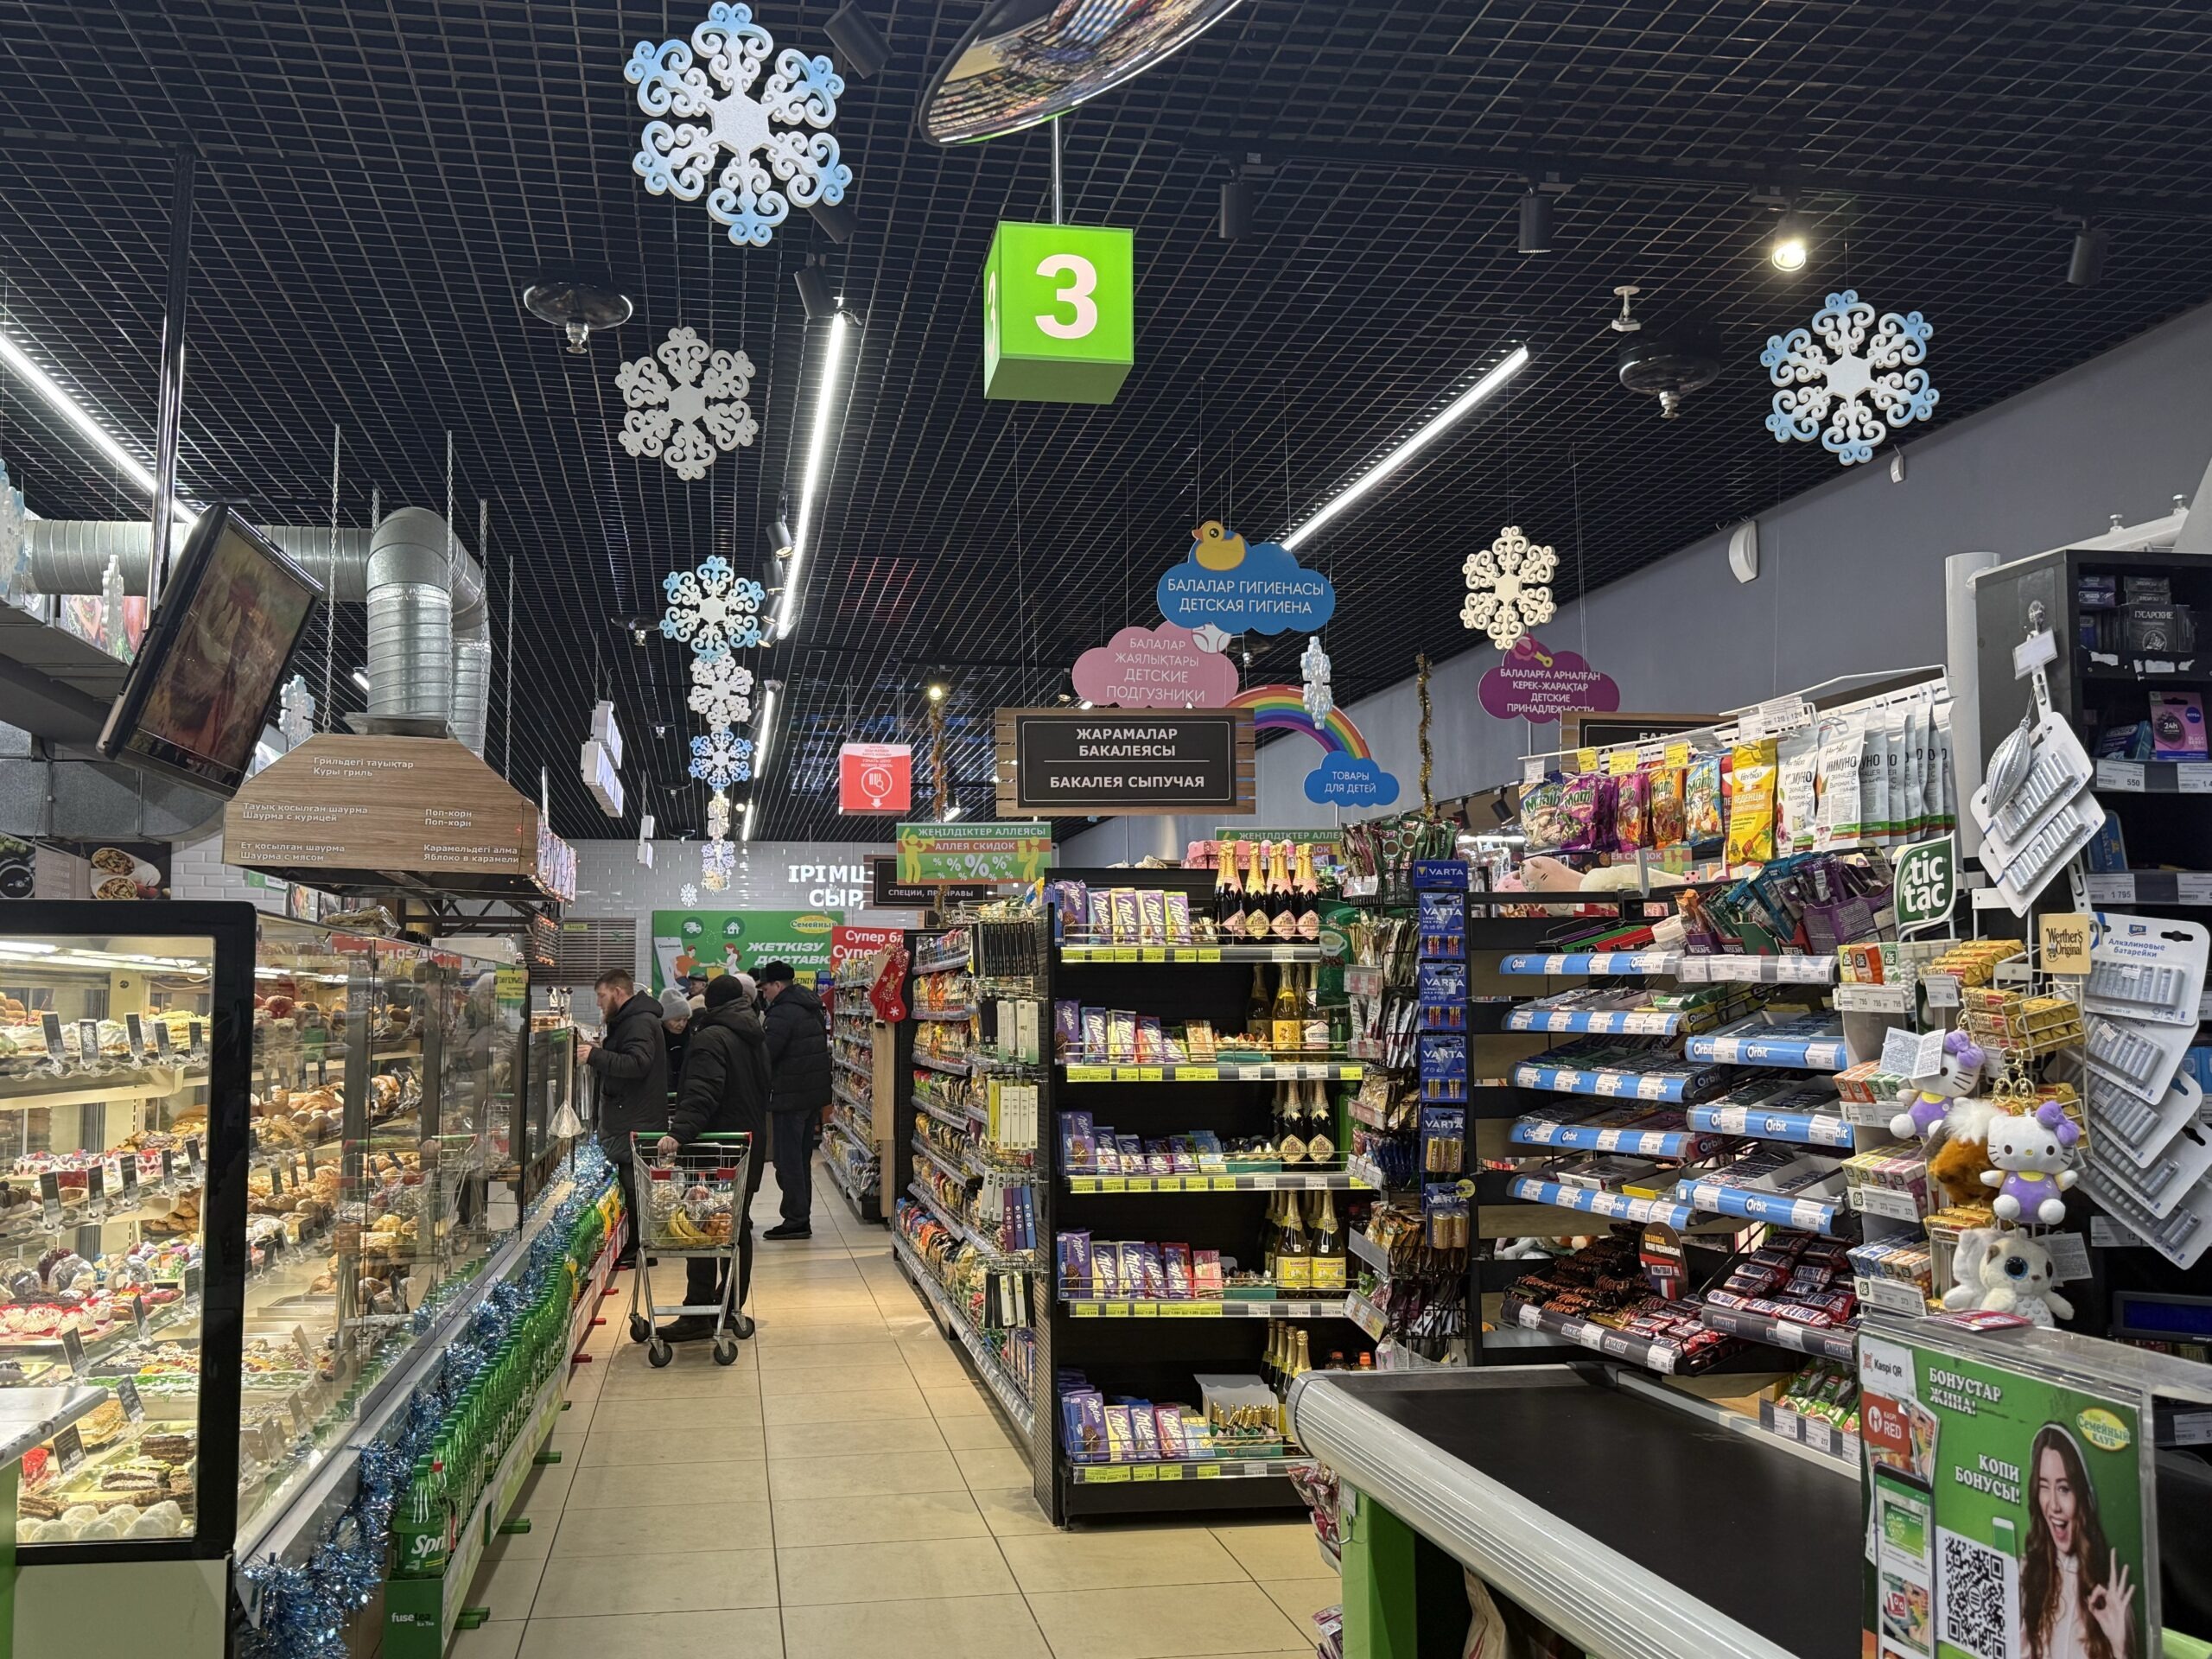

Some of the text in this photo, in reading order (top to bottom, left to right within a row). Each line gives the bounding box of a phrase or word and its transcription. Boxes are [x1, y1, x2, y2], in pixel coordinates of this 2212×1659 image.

[1035, 253, 1097, 339] 3
[1167, 578, 1324, 595] БАЛАЛАР ГИГИЕНАСЫ
[1179, 598, 1312, 614] ДЕТСКАЯ ГИГИЕНА
[2135, 610, 2174, 620] ГУСАРСКИЕ
[1129, 638, 1185, 651] БАЛАЛАР
[1115, 652, 1198, 667] ЖАЯЛЫҚТАРЫ
[1124, 668, 1188, 683] ДЕТСКИЕ
[1500, 669, 1600, 681] БАЛАЛАРҒА АРНАЛҒАН
[1106, 685, 1205, 702] ПОДГУЗНИКИ
[1512, 681, 1588, 693] КЕРЕК-ЖАРАҚТАР
[1530, 692, 1570, 702] ДЕТСКИЕ
[1076, 728, 1178, 740] ЖАРАМАЛАР
[1079, 745, 1175, 757] БАКАЛЕЯСЫ
[314, 757, 414, 769] Грильдегі тауықтар
[1826, 756, 1857, 772] ИММУНО
[314, 767, 340, 777] Куры
[1332, 771, 1369, 781] ТОВАРЫ
[1050, 776, 1205, 788] БАКАЛЕЯ СЫПУЧАЯ
[1325, 784, 1376, 794] ДЛЯ ДЕТЕЙ
[2127, 779, 2140, 787] 550
[244, 802, 276, 812] Тауық
[327, 806, 368, 816] шаурма
[425, 809, 472, 818] Поп-корн
[243, 811, 284, 822] Шаурма
[295, 813, 337, 823] курицей
[425, 818, 472, 828] Поп-корн
[918, 827, 1046, 838] ЖЕҢІЛДІКТЕР АЛЛЕЯСЫ
[1239, 831, 1309, 842] ЖЕҢІЛДІКТЕР
[423, 843, 491, 855] Карамельдегі
[935, 842, 1015, 851] АЛЛЕЯ СКИДОК
[240, 852, 282, 861] Шаурма
[423, 854, 460, 862] Яблоко
[1624, 852, 1662, 861] СКДОК
[1910, 850, 1944, 886] tic
[888, 889, 925, 898] СПЕЦИИ,
[1904, 883, 1945, 913] tac
[1093, 897, 1113, 931] Milka
[1117, 897, 1135, 936] Milka
[1144, 896, 1164, 936] Milka
[1170, 897, 1189, 936] Milka
[1423, 907, 1463, 916] VARTA
[845, 930, 886, 944] Супер
[2046, 927, 2083, 944] Werther's
[747, 942, 825, 951] ЖЕТКІЗУ
[2056, 943, 2082, 958] Original
[2108, 938, 2165, 951] Алкалиновые
[2113, 946, 2158, 958] батарейки
[754, 955, 831, 965] ДОСТАВК
[1512, 958, 1526, 969] Orbit
[1630, 957, 1643, 968] Orb
[1425, 978, 1465, 987] VARTA
[1089, 1014, 1106, 1052] Milka
[1116, 1015, 1133, 1052] Milka
[1694, 1042, 1714, 1056] Orbit
[1747, 1044, 1768, 1058] Orbit
[1698, 1071, 1719, 1087] Orbit
[1426, 1120, 1464, 1128] VARTA
[1765, 1117, 1788, 1133] Orbit
[1523, 1128, 1536, 1139] Orb
[1561, 1128, 1578, 1141] Orbit
[1836, 1126, 1848, 1139] bit
[1700, 1136, 1724, 1151] Orbit
[1428, 1196, 1467, 1205] VARTA
[1746, 1197, 1767, 1213] Orbit
[1098, 1250, 1116, 1289] Milka
[1128, 1247, 1143, 1289] Milka
[1145, 1251, 1161, 1287] Milka
[1561, 1324, 1581, 1339] SNICKERS
[1713, 1317, 1737, 1332] SNICKERS
[1605, 1338, 1628, 1353] SNICKERS
[1826, 1341, 1853, 1358] SNICKERS
[1874, 1358, 1903, 1377] Kaspi QR
[1929, 1367, 2002, 1402] БОНУСТАР
[1929, 1387, 1976, 1415] ЖИНА!
[1087, 1397, 1101, 1424] Milka
[1884, 1411, 1897, 1421] KASPI
[1113, 1413, 1132, 1450] Milka
[1135, 1412, 1154, 1450] Milka
[1163, 1413, 1181, 1450] Milka
[1884, 1421, 1902, 1440] RED
[2077, 1415, 2130, 1443] Семейный
[2091, 1433, 2116, 1447] КЛУБ
[1979, 1453, 2019, 1483] КОПИ
[1955, 1465, 2020, 1504] БОНУСЫ!
[411, 1534, 446, 1558] Spri
